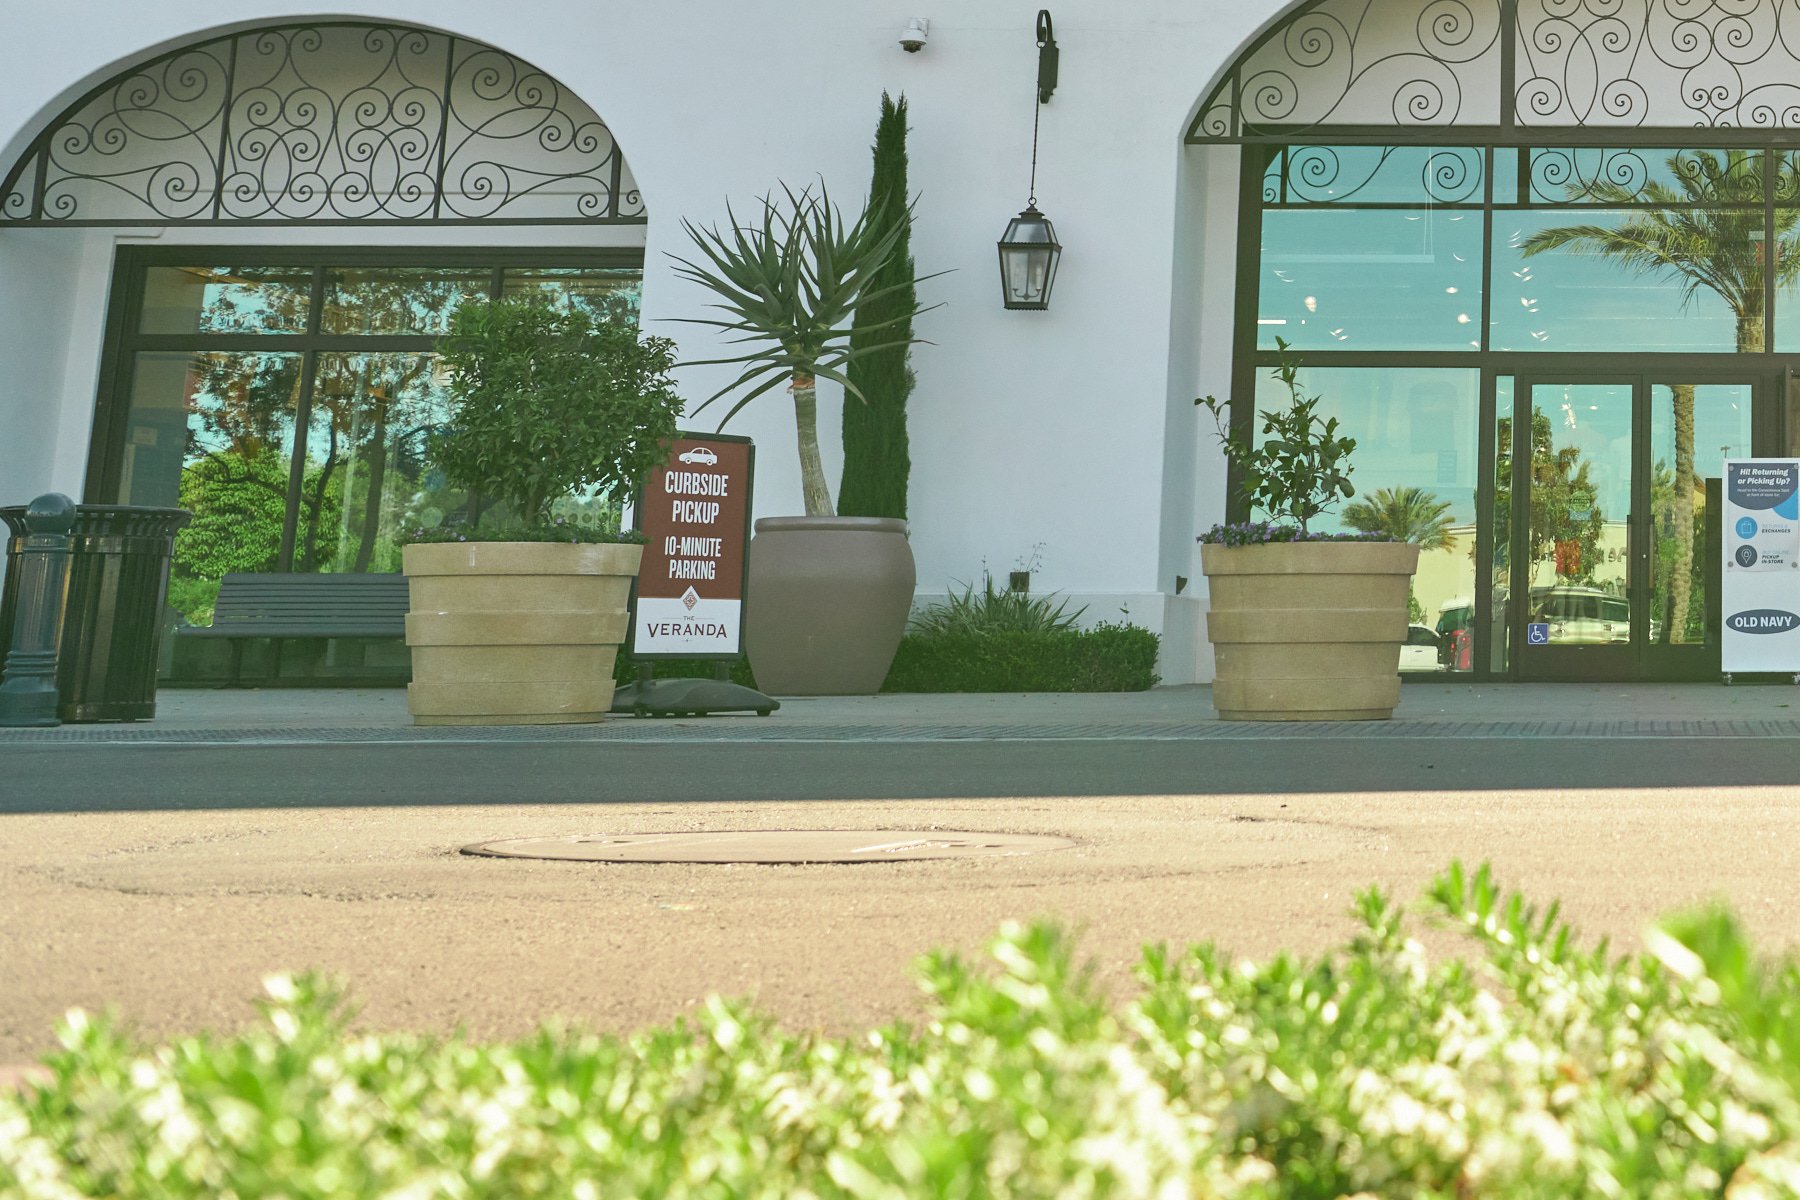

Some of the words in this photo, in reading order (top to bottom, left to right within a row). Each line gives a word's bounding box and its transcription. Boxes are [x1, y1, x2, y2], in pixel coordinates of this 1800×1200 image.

[1740, 468, 1751, 476] Hi!
[1752, 468, 1789, 477] Returning
[1747, 477, 1775, 486] Picking
[1775, 477, 1791, 486] Up?
[665, 471, 729, 496] CURBSIDE
[672, 500, 720, 524] PICKUP
[665, 536, 722, 557] 10-MINUTE
[669, 559, 716, 580] PARKING
[647, 623, 727, 638] VERANDA
[1734, 616, 1758, 628] OLD
[1760, 616, 1792, 627] NAVY
